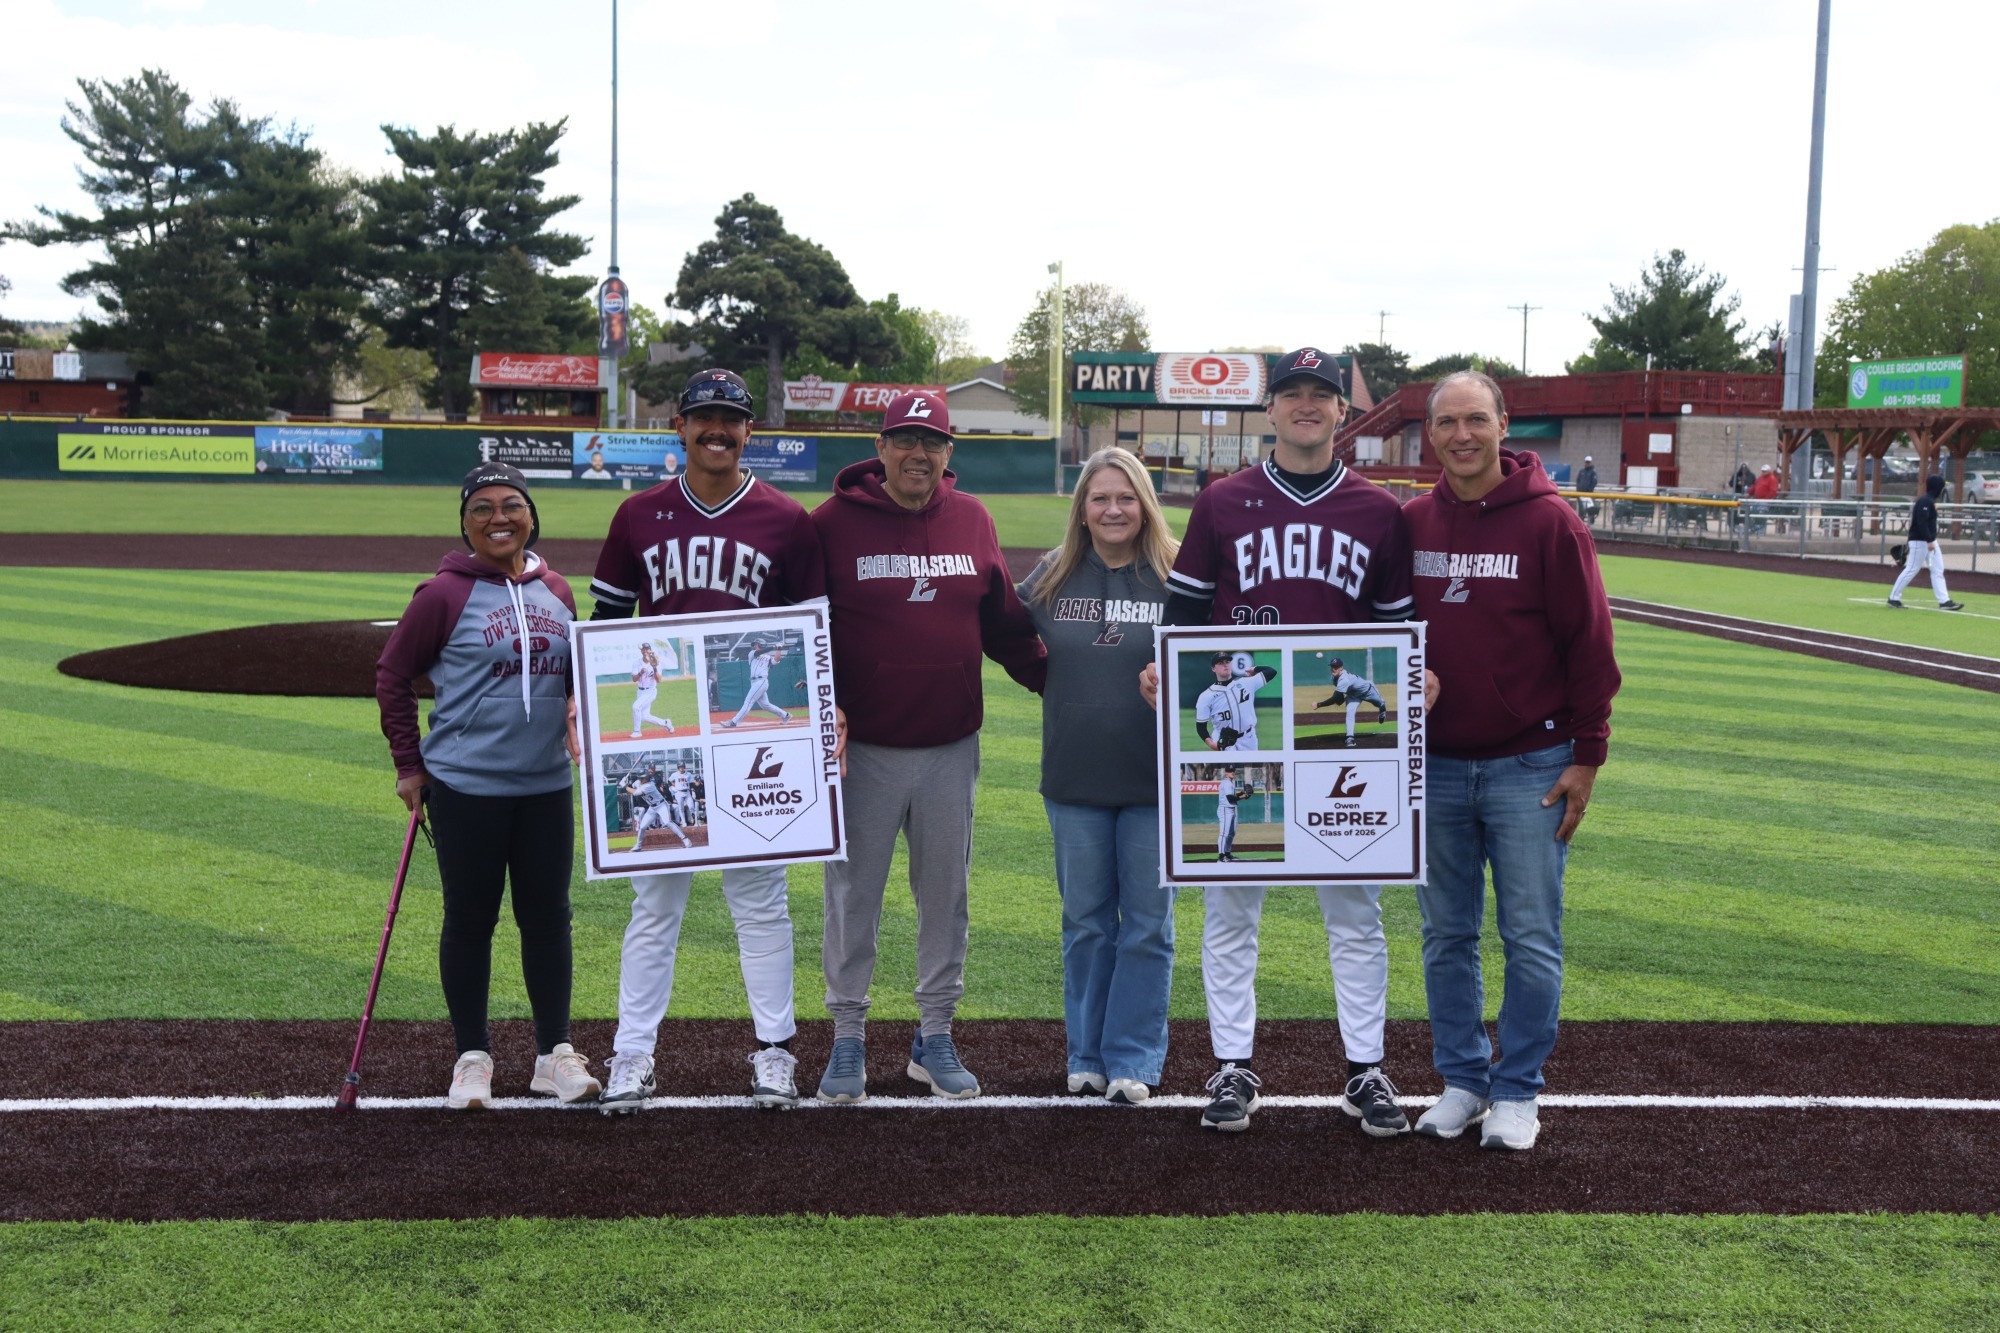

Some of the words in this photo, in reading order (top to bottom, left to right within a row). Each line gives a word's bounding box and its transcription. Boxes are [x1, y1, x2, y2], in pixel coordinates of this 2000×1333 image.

[1867, 364, 1895, 375] COULEE
[1896, 362, 1925, 373] REGION
[1926, 359, 1963, 371] ROOFING
[1077, 365, 1151, 390] PARTY
[1169, 387, 1212, 395] BRICKL
[1882, 393, 1942, 406] 608-780-5582
[103, 425, 147, 434] PROUD
[150, 426, 211, 436] SPONSOR
[607, 435, 637, 445] Strive
[103, 446, 249, 462] MorriesAuto.com
[271, 439, 353, 459] Heritage
[499, 448, 530, 456] FLYWAY
[532, 448, 557, 456] FENCE
[314, 454, 378, 467] Xteriors
[477, 474, 510, 483] Eagles
[857, 554, 910, 581] EAGLES
[909, 555, 977, 578] BASEBALL
[1234, 522, 1371, 600] EAGLES
[1448, 554, 1519, 579] BASEBALL
[642, 535, 771, 608] EAGLES
[541, 608, 552, 618] OF
[1054, 598, 1102, 622] EAGLES
[814, 634, 830, 679] UWL
[1237, 658, 1245, 669] 6
[493, 656, 565, 678] BASBALL
[1407, 654, 1422, 701] UWL
[1218, 710, 1231, 721] 30
[817, 684, 838, 783] BASEBALL
[1407, 706, 1423, 806] BASEBALL
[747, 782, 784, 791] Emiliano
[731, 790, 803, 808] RAMOS
[740, 810, 763, 818] Class
[774, 807, 796, 816] 2026
[1307, 811, 1388, 826] DEPREZ
